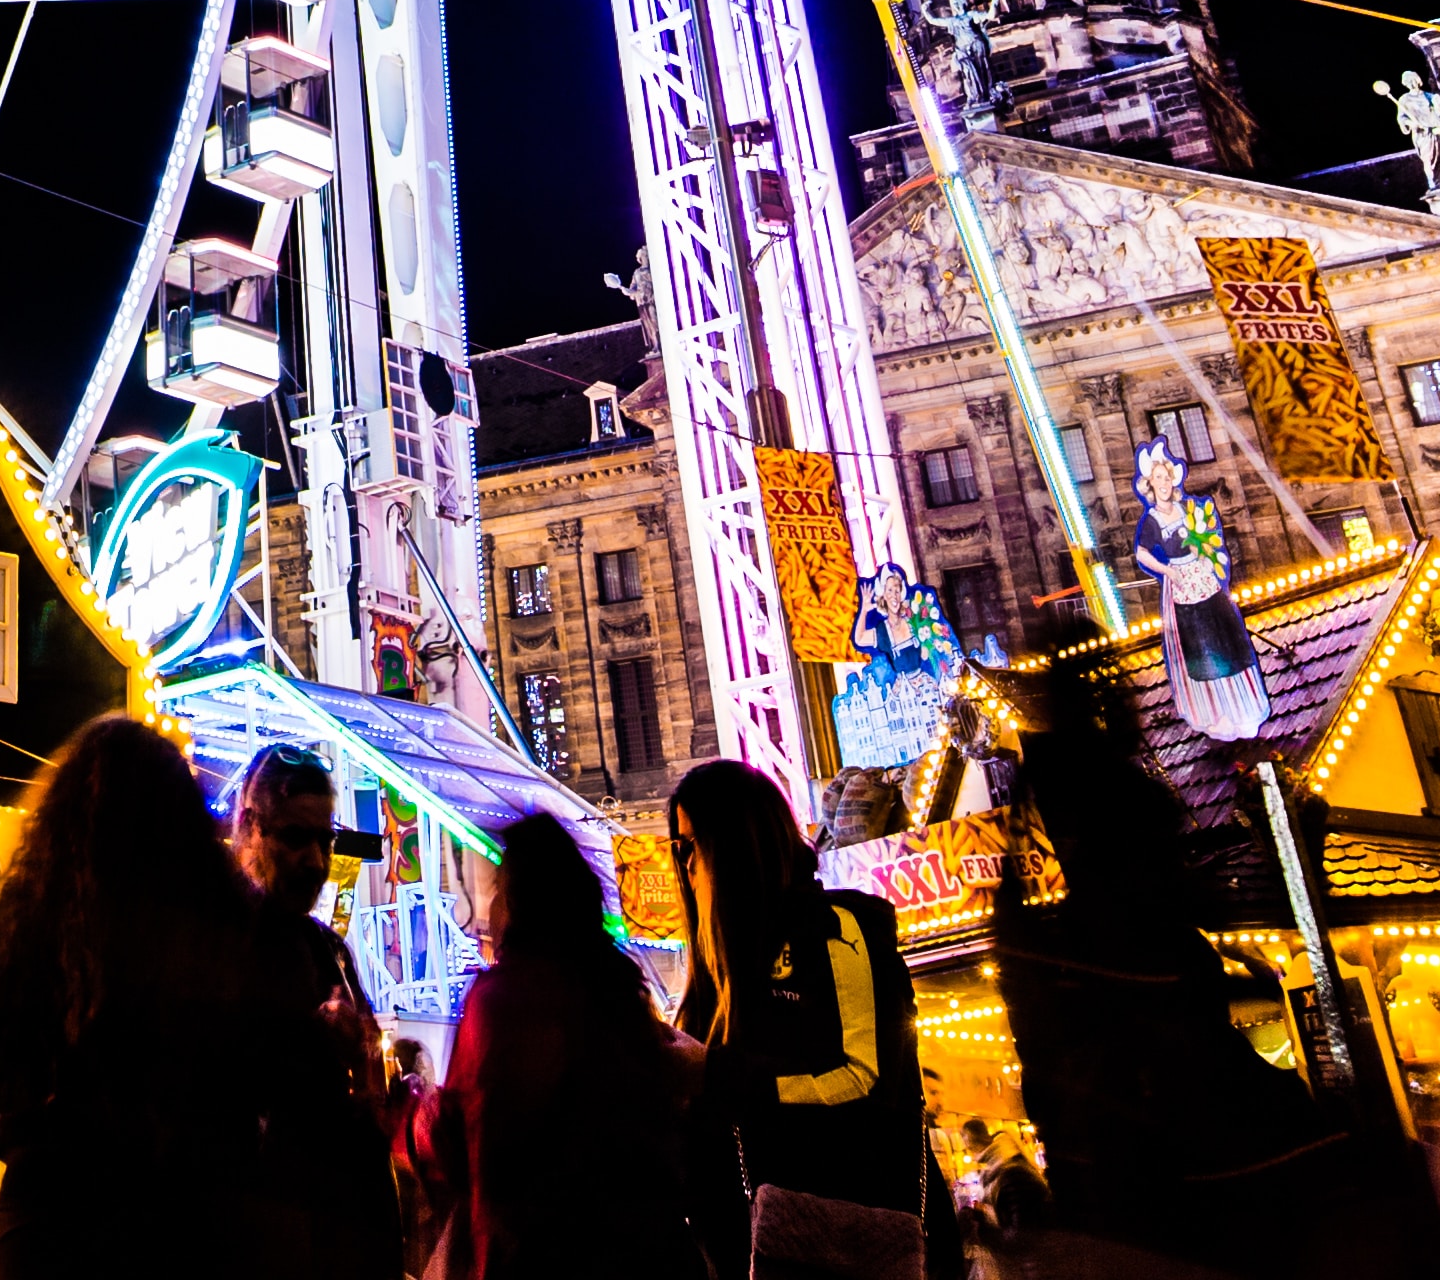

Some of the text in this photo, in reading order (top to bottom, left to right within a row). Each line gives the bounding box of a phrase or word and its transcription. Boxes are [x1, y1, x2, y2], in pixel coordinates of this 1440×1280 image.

[1221, 282, 1321, 315] XXL
[1235, 321, 1329, 342] FRITES
[767, 488, 836, 517] XXL
[775, 523, 841, 541] FRITES
[640, 873, 672, 889] XXL
[870, 851, 1043, 910] XXL FRIES
[640, 889, 677, 906] frites
